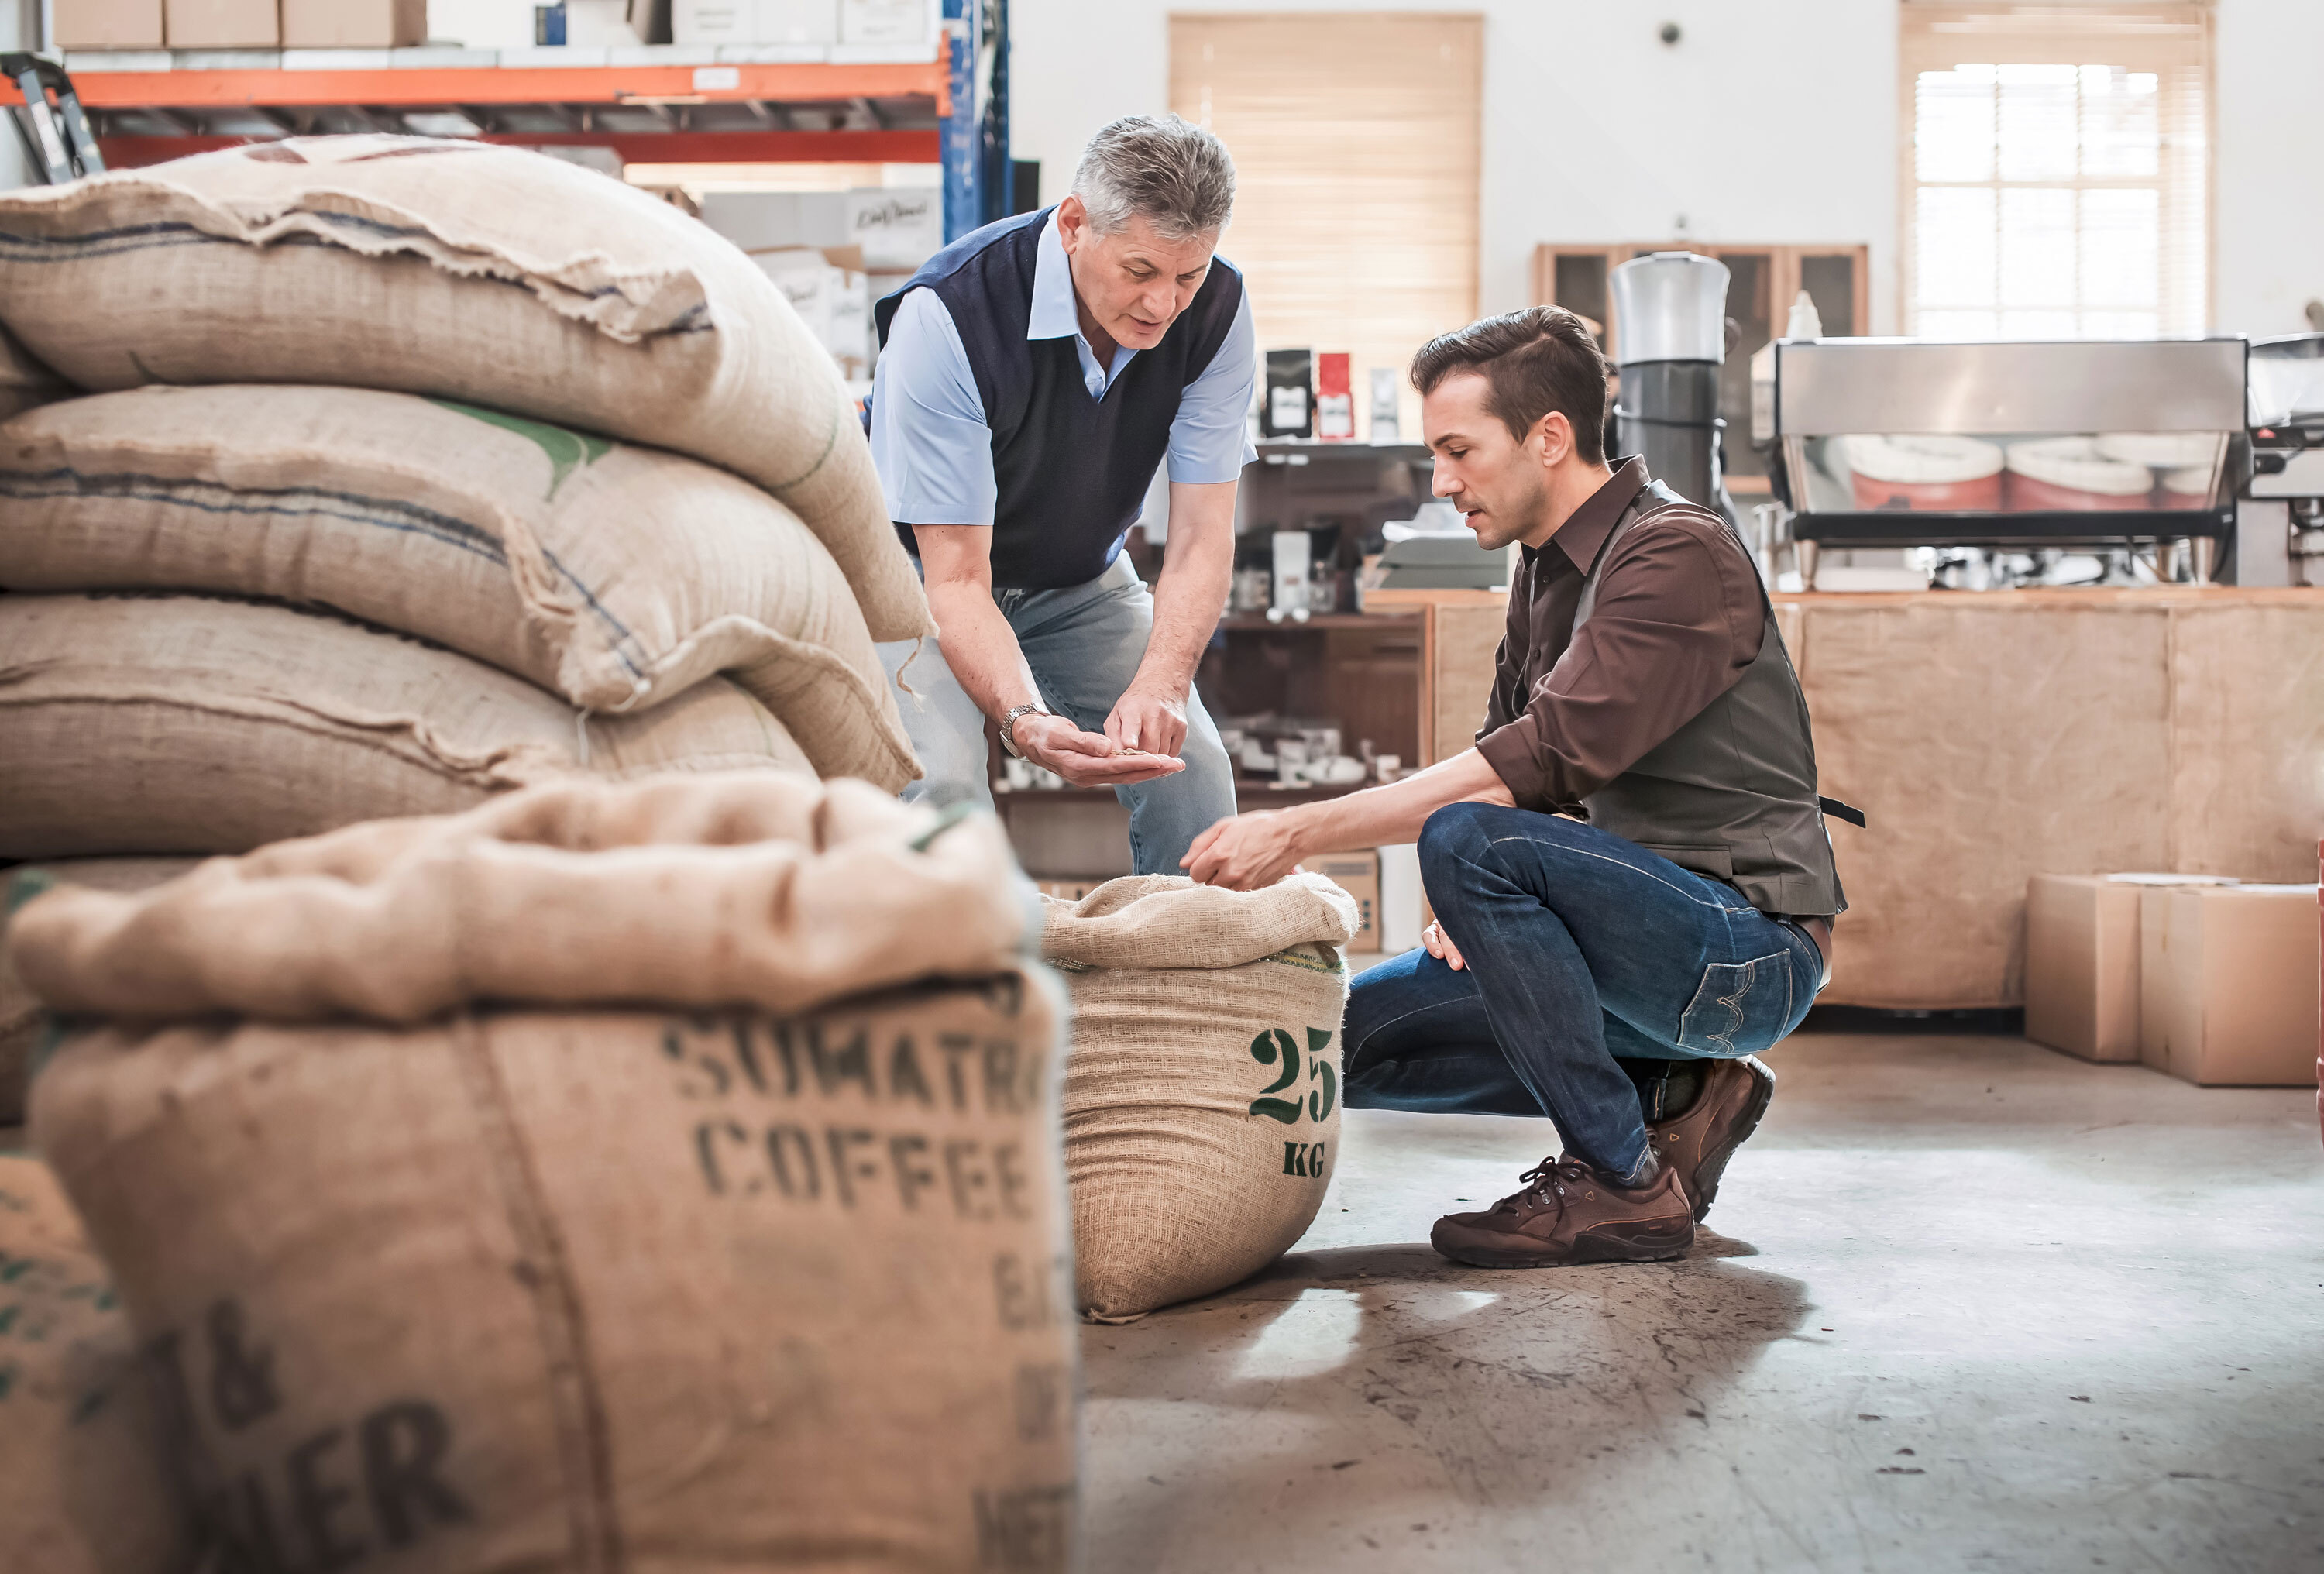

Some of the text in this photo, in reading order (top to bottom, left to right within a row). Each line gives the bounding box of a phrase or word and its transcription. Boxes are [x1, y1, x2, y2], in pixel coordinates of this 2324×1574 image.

[1249, 1026, 1336, 1125] 25
[696, 1114, 1033, 1221] COFFEE
[1282, 1141, 1325, 1178] KG
